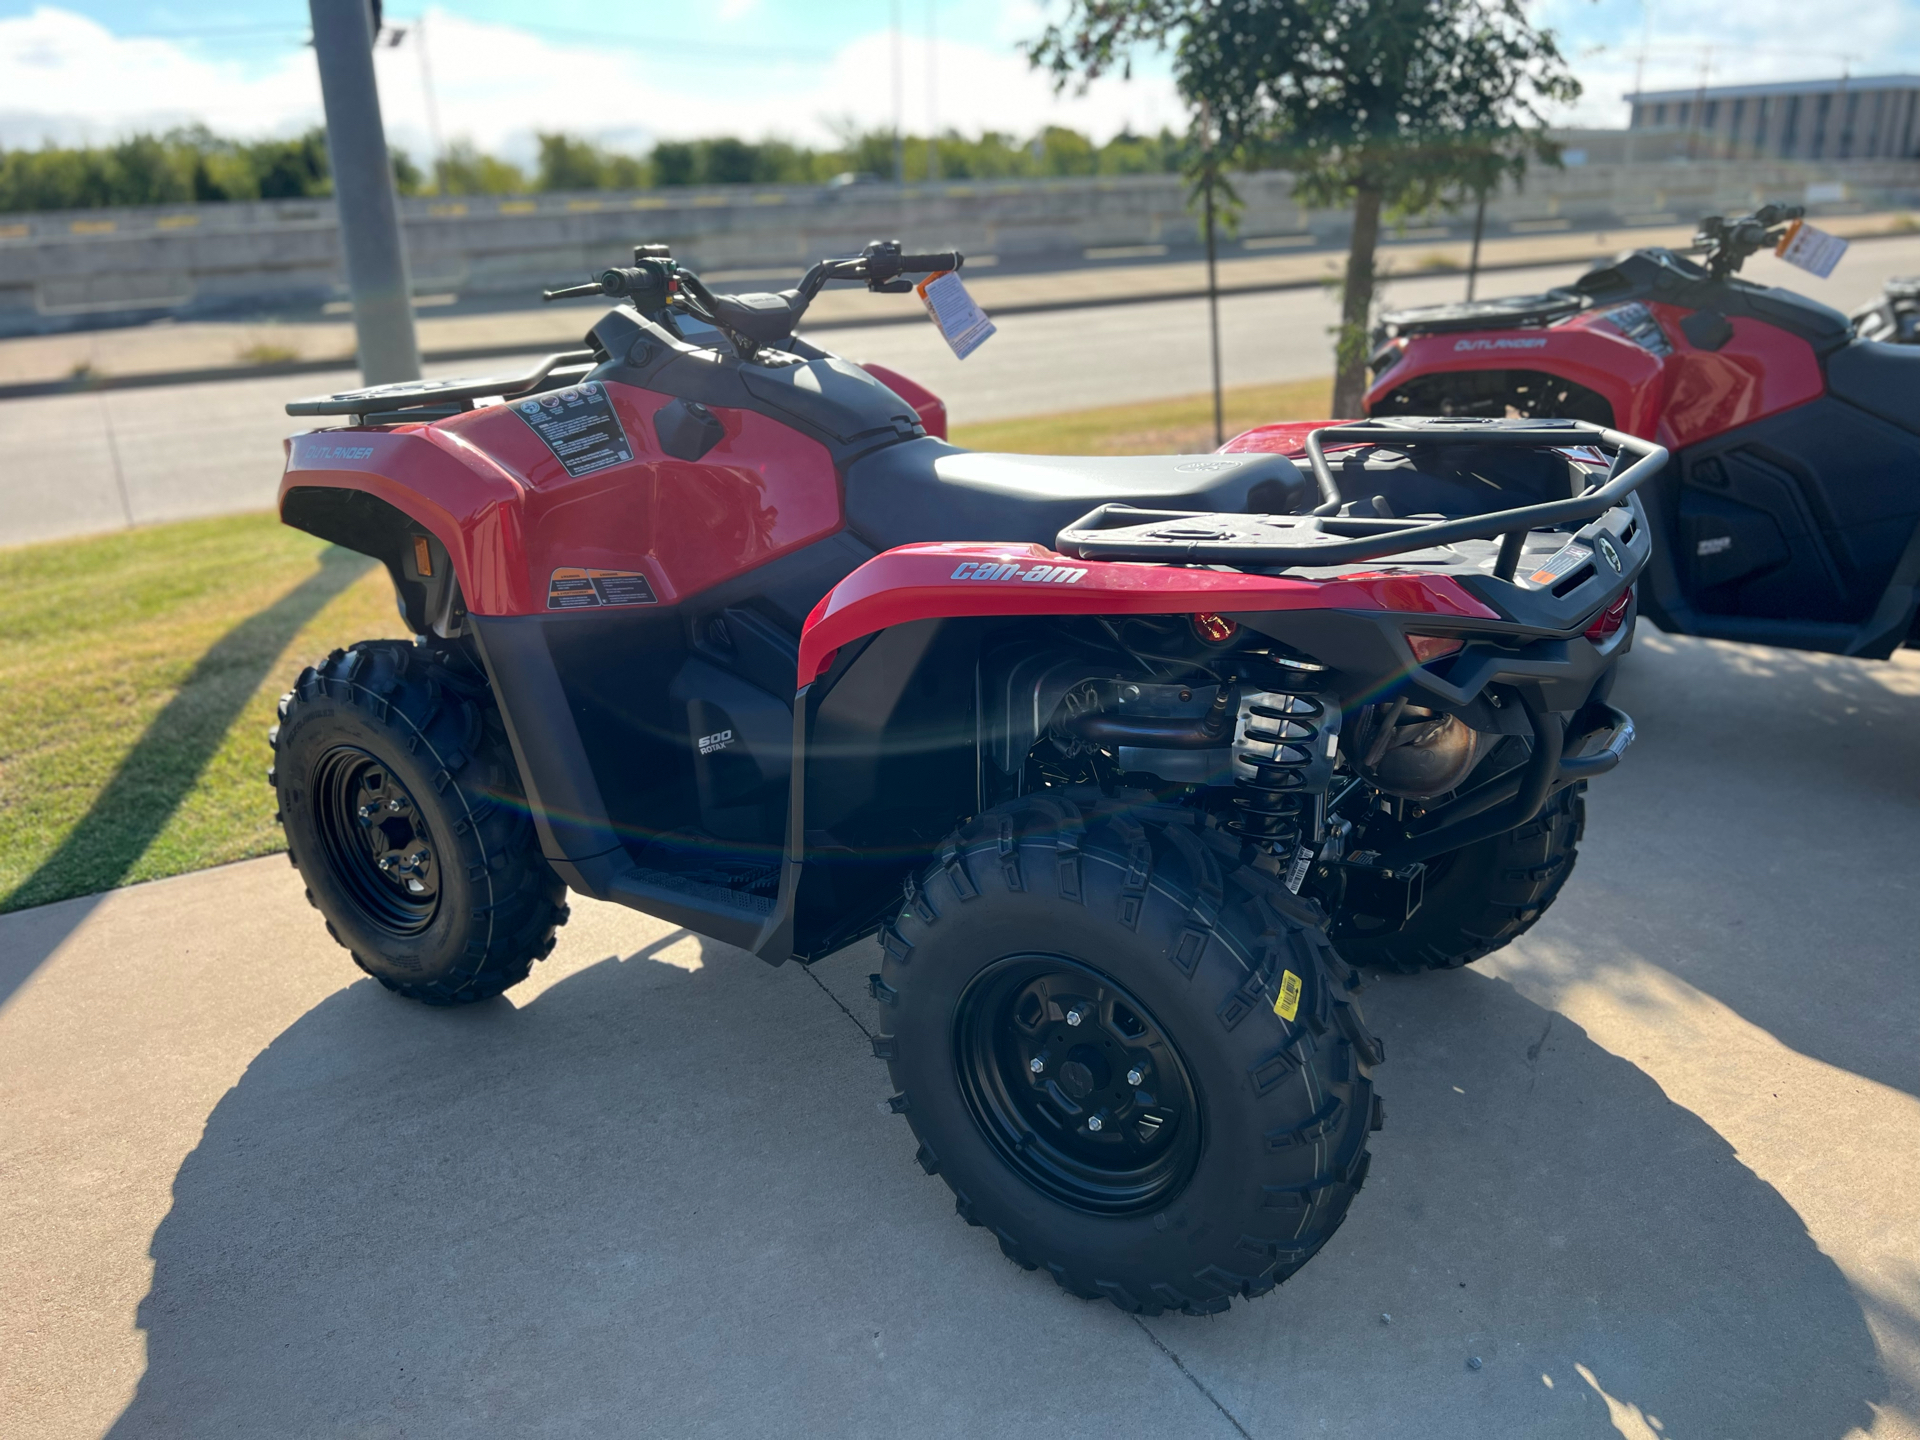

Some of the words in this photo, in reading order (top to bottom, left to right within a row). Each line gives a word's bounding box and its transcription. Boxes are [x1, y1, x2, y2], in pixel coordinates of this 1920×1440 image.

[1453, 338, 1547, 352] OUTLANDER
[305, 445, 374, 459] OUTLANDER
[950, 562, 1088, 584] can-am
[698, 729, 732, 748] 500
[700, 741, 727, 755] ROTAX
